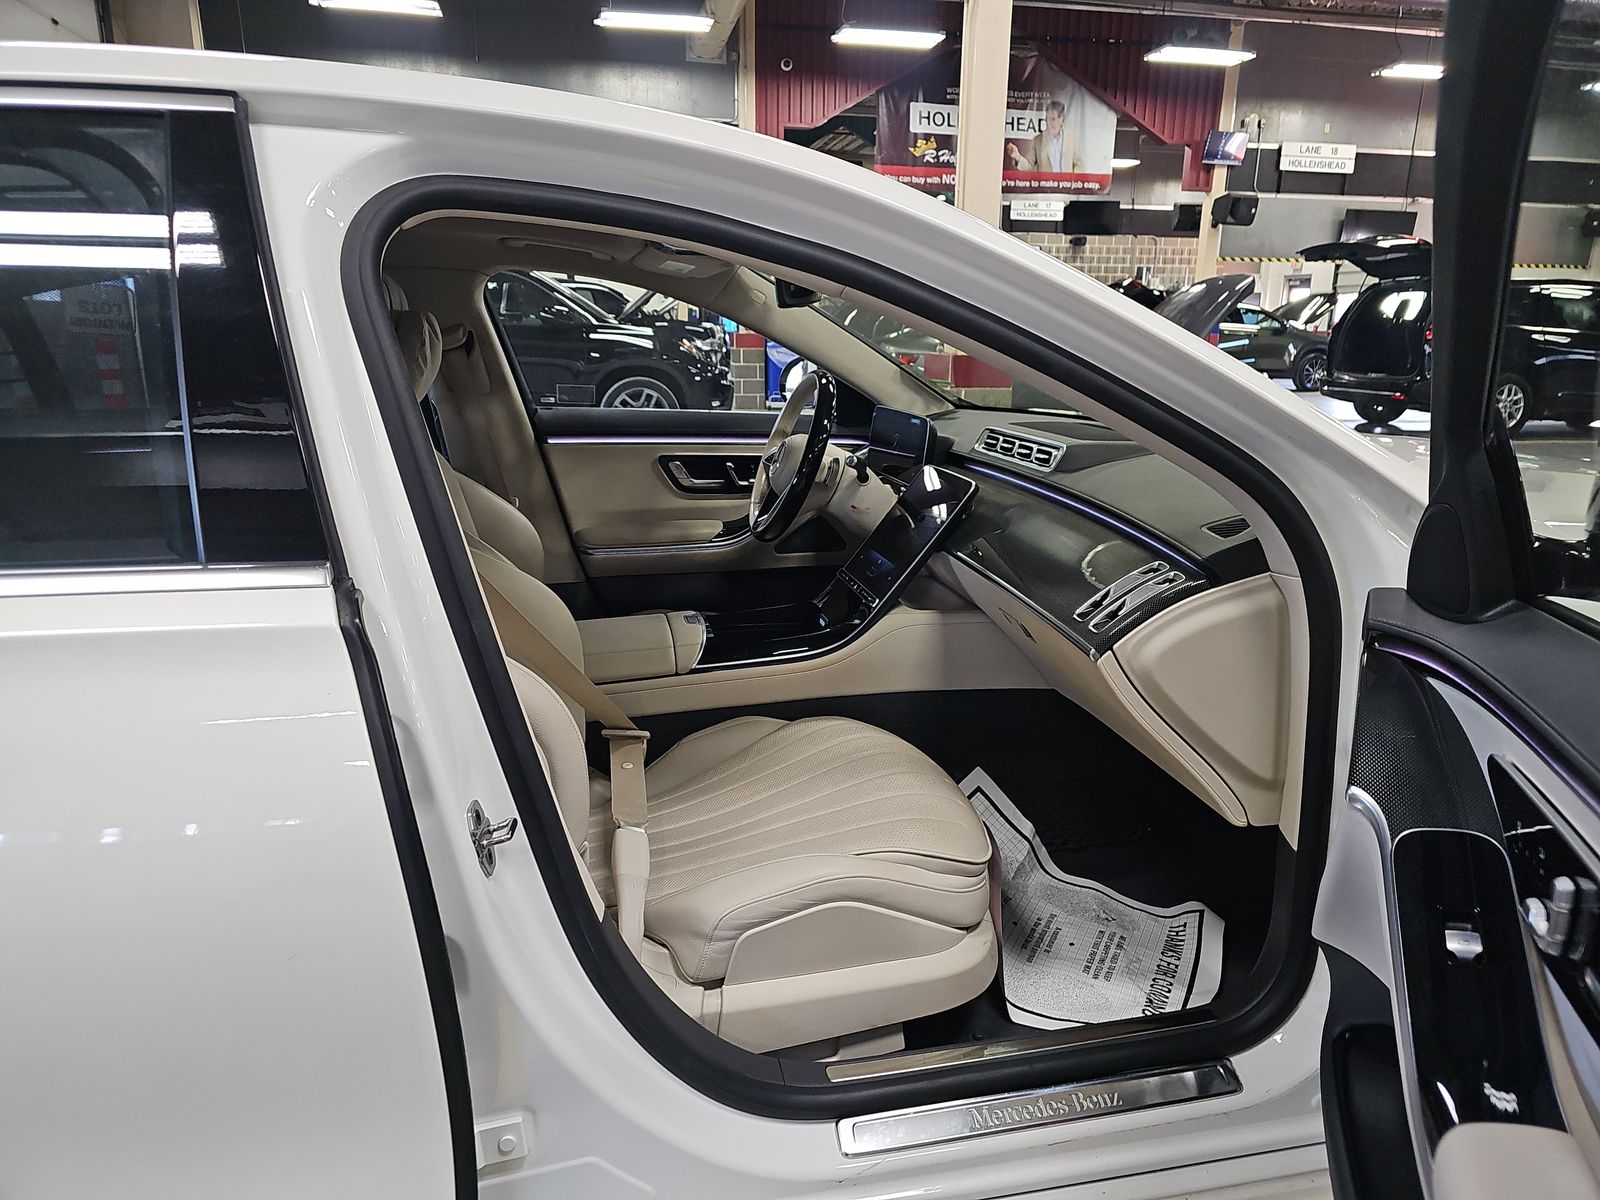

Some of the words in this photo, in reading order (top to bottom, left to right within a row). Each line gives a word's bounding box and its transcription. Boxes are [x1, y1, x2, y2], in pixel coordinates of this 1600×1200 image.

[1299, 144, 1322, 155] LANE
[1330, 147, 1339, 156] 18
[1288, 158, 1347, 170] HOLLENSHEAD
[912, 176, 926, 185] buy
[926, 176, 941, 184] with
[1015, 179, 1031, 187] here
[1031, 179, 1039, 187] to
[1040, 180, 1059, 188] make
[1071, 180, 1083, 189] job
[1083, 182, 1101, 190] easy.
[1160, 921, 1188, 961] THANKS
[1085, 949, 1098, 965] PAPER
[1081, 963, 1092, 975] MAT
[1091, 965, 1104, 980] CLEAN
[1154, 957, 1180, 979] FOR
